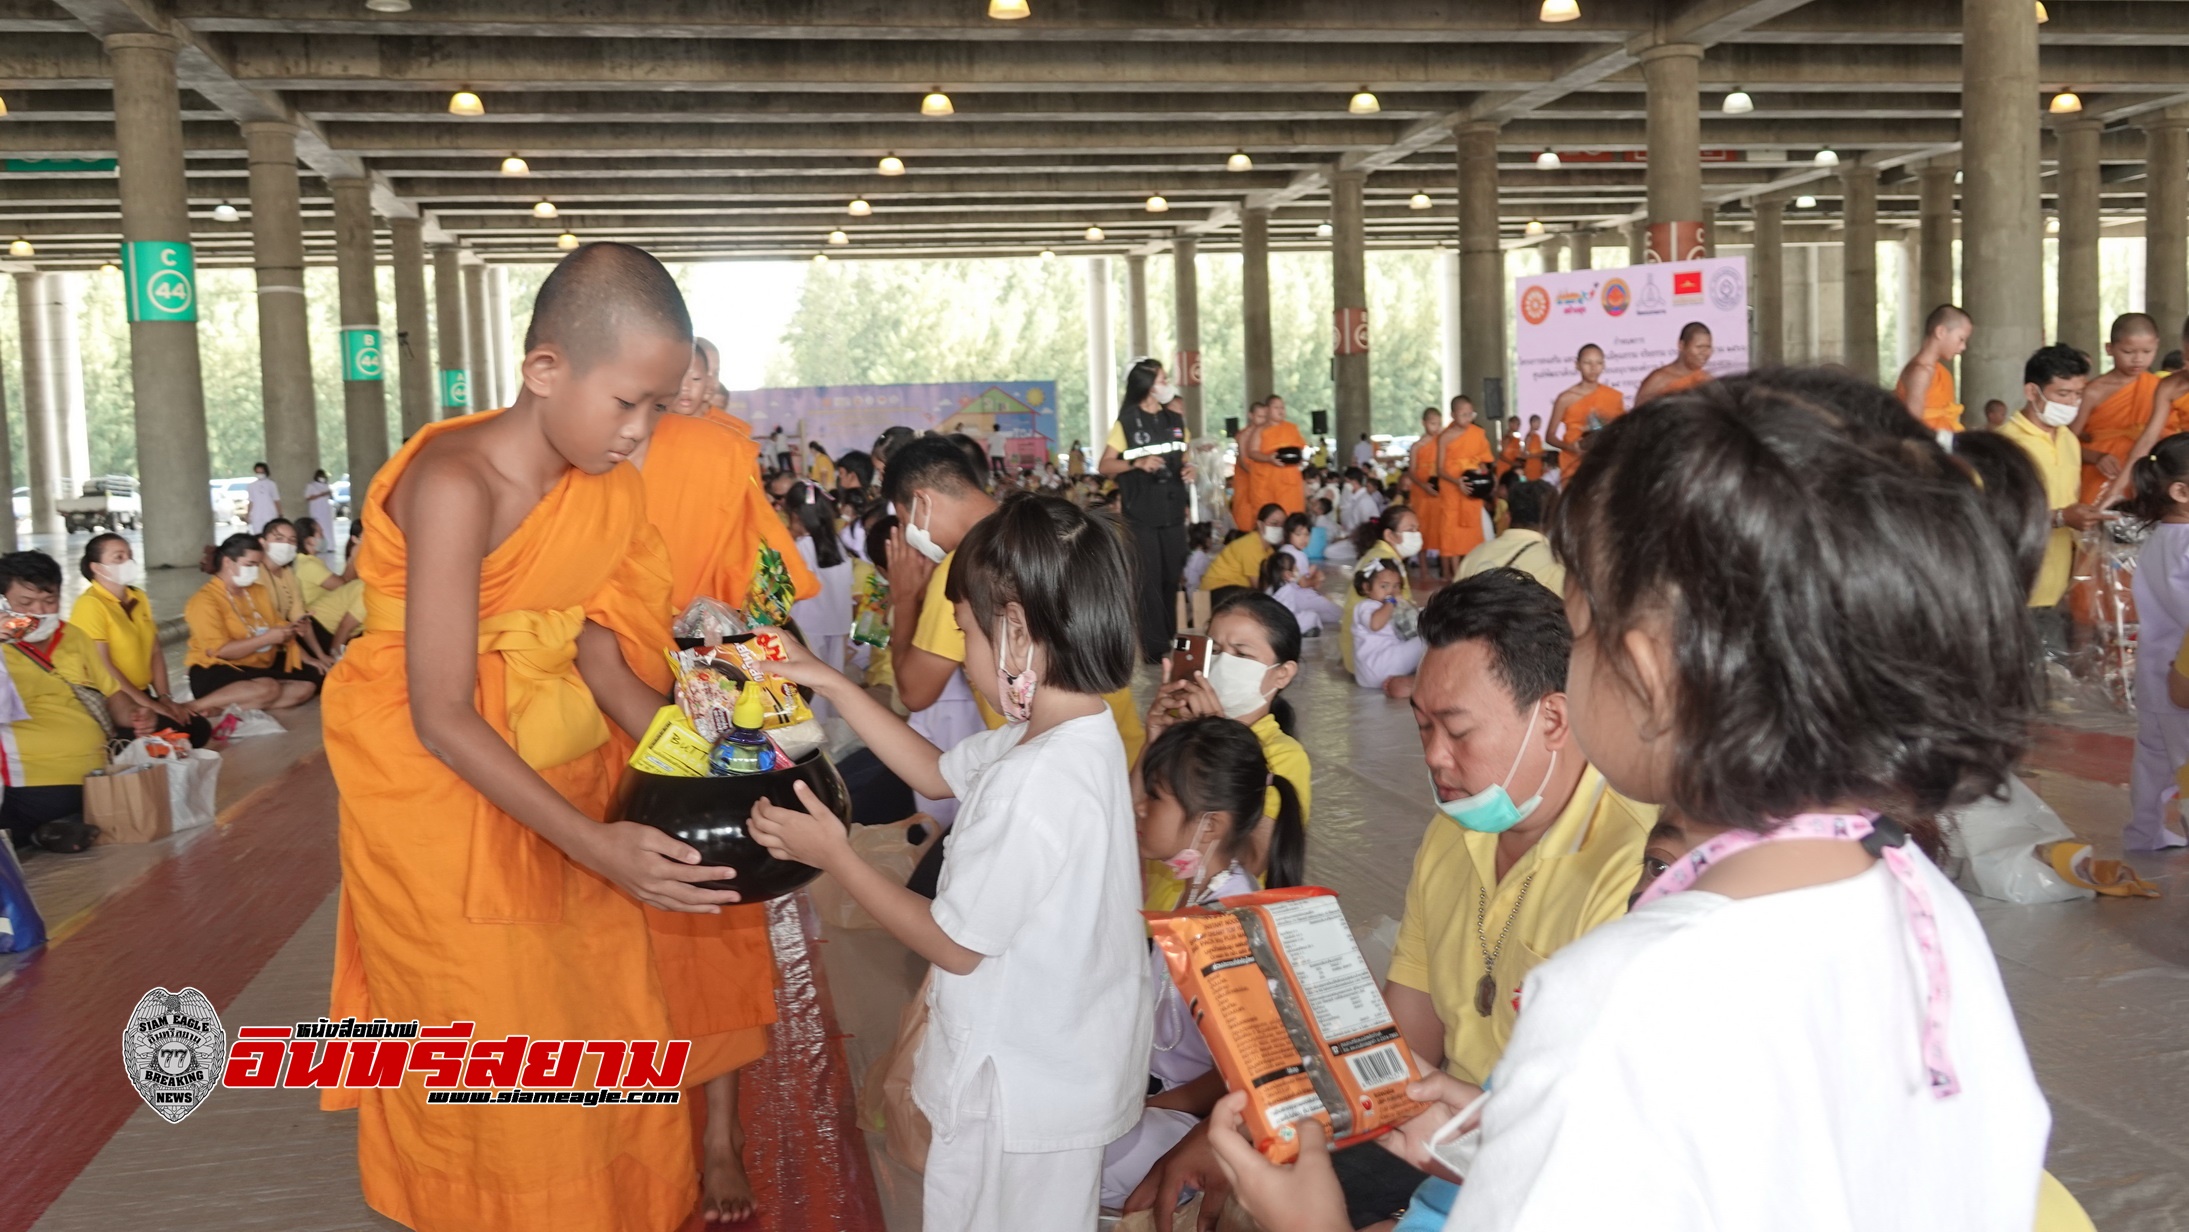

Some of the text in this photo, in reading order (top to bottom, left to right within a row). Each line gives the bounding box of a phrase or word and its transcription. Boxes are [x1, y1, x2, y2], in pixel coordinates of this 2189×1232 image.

[161, 248, 177, 267] C
[155, 282, 187, 300] 44
[363, 334, 375, 346] B
[361, 355, 379, 366] 44
